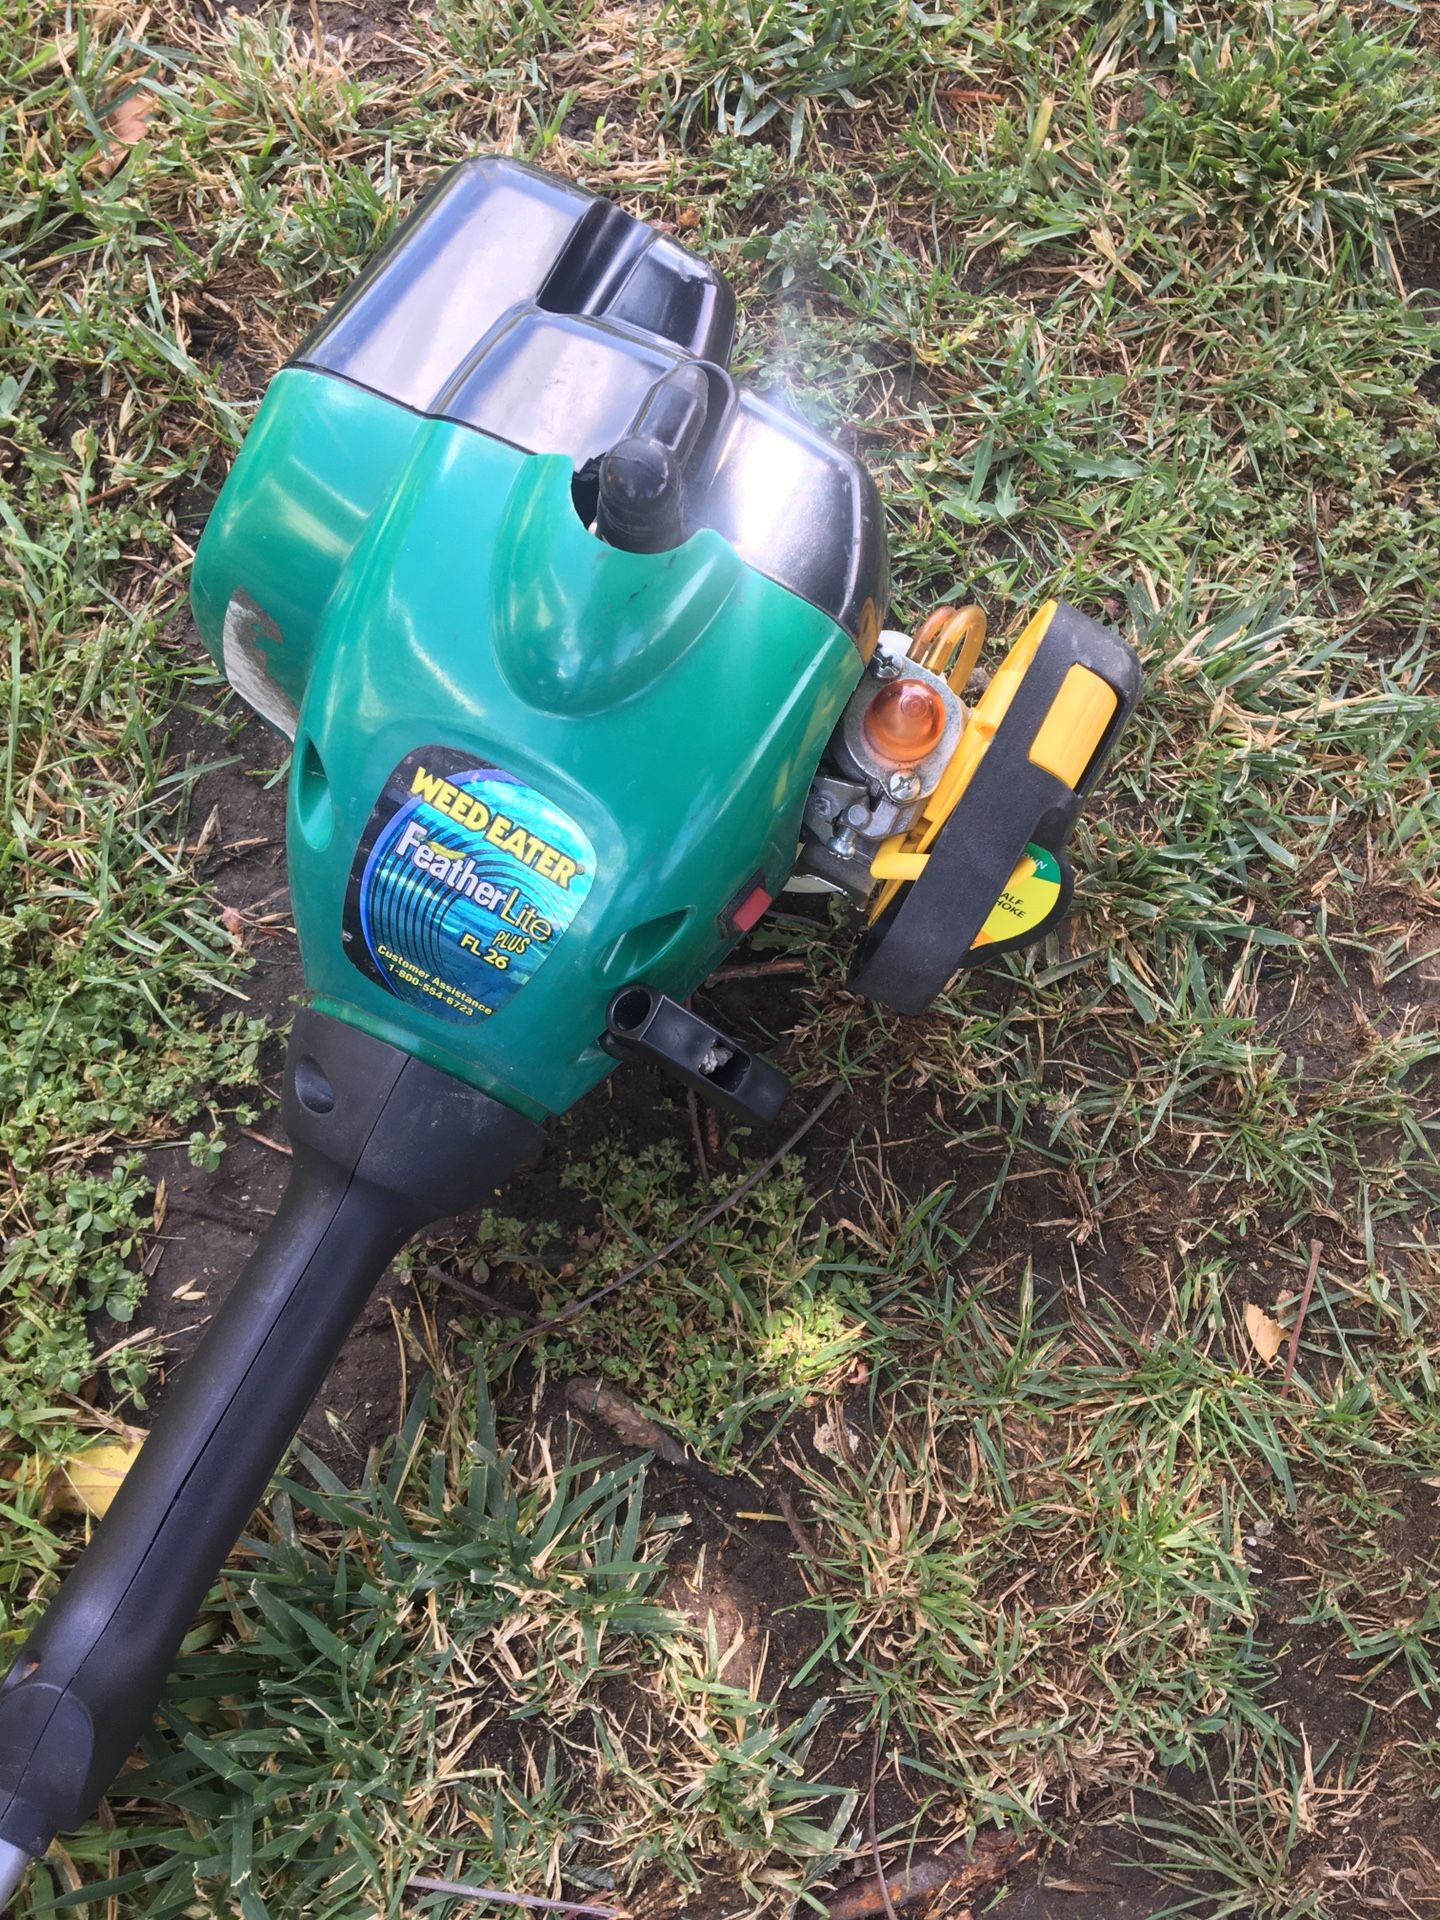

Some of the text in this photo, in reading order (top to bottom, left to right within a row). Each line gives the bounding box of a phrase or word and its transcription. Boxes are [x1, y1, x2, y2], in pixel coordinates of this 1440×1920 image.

[410, 766, 491, 832] WEED
[996, 900, 1027, 919] HOKE
[1000, 892, 1024, 906] ALF
[460, 933, 510, 970] FL 26
[491, 930, 531, 954] PLUS
[377, 944, 494, 1016] Customer Assistance
[388, 962, 475, 1017] 1-800-554-6723
